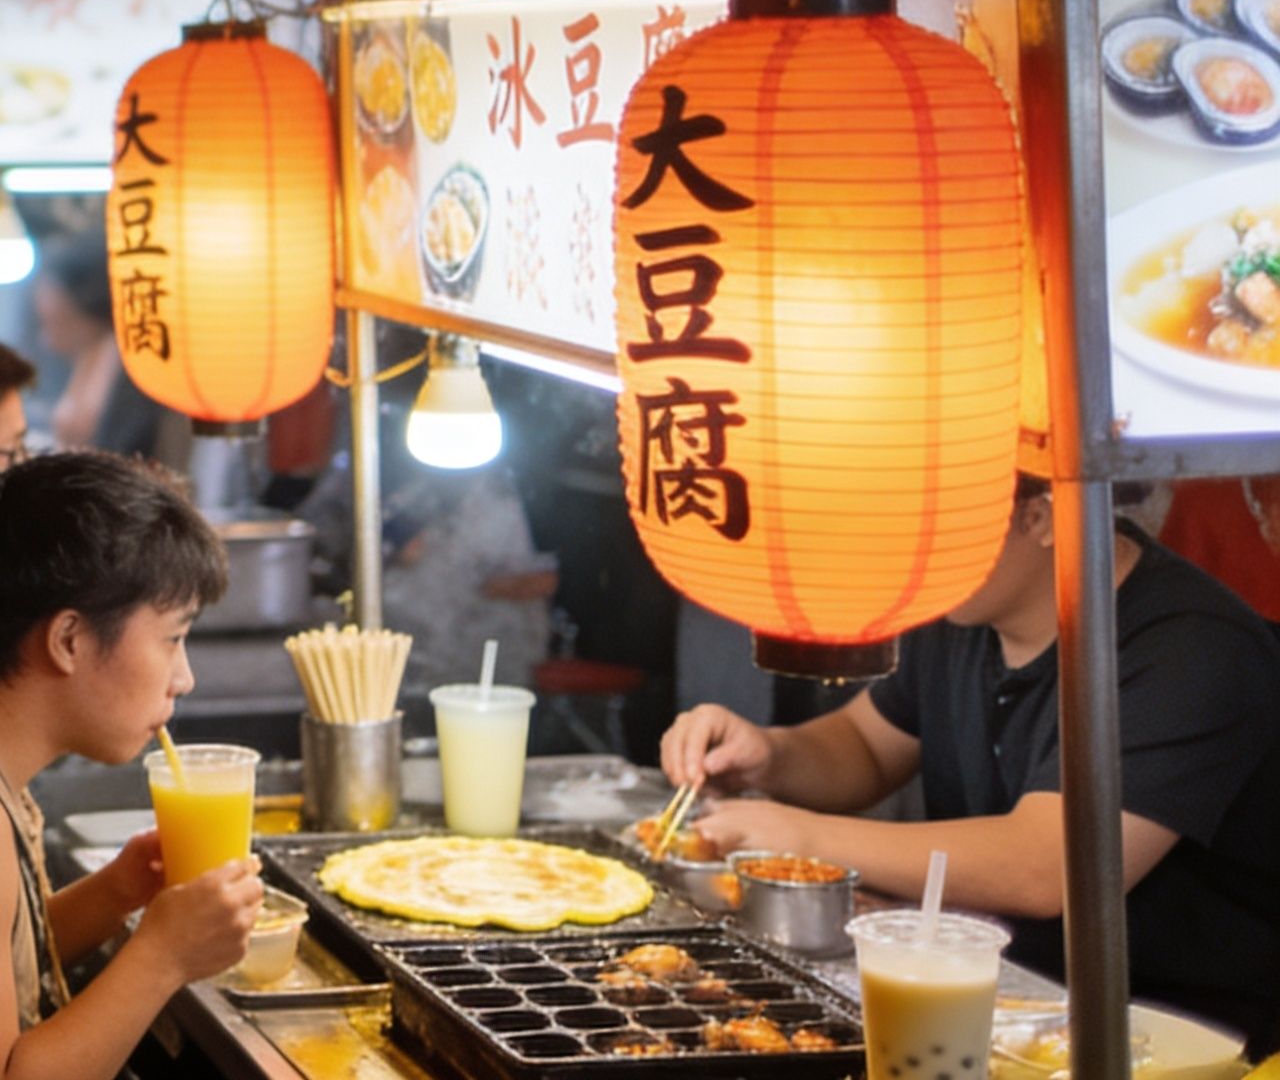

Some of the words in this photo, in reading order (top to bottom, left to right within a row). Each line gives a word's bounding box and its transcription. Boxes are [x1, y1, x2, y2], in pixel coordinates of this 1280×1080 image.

[115, 93, 170, 361] 大豆腐
[621, 85, 755, 542] 大豆腐
